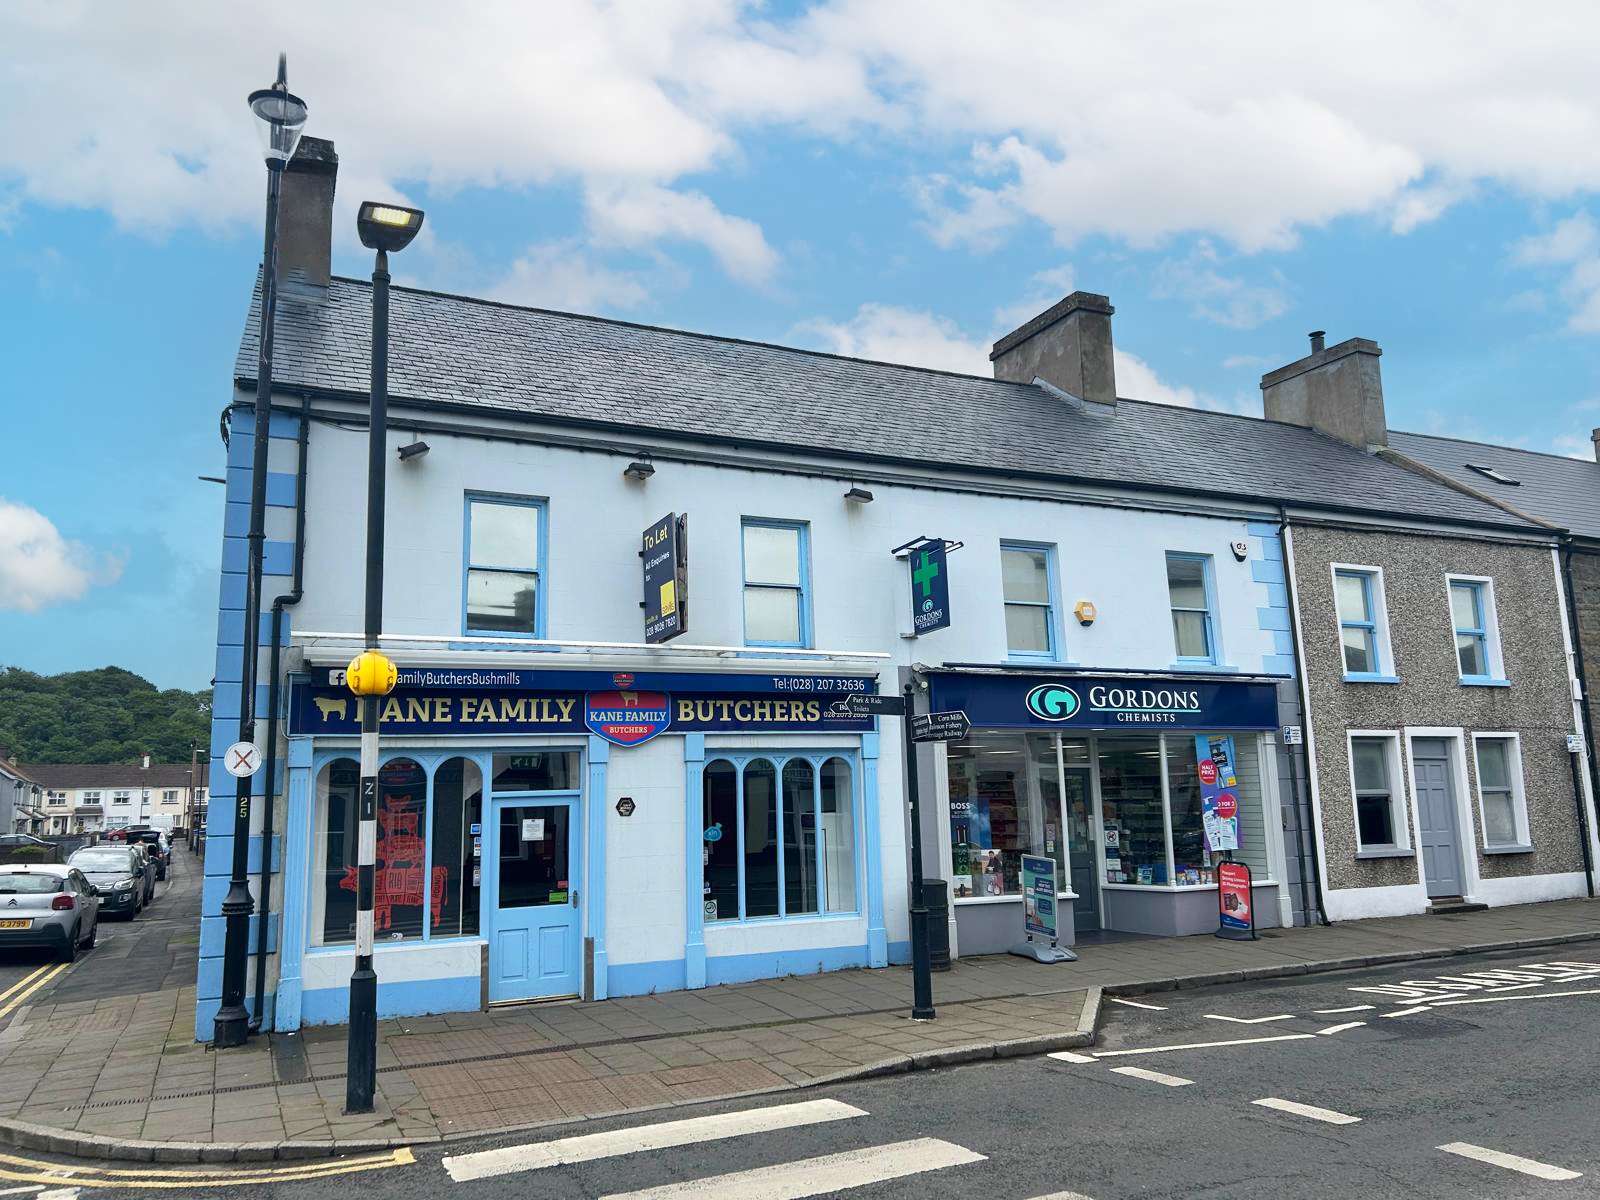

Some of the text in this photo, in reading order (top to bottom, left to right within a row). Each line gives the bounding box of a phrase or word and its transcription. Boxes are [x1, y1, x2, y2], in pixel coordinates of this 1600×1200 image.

[645, 524, 668, 550] To Let
[914, 608, 943, 625] GORDONS
[395, 671, 520, 688] amilyButchersBushmills
[773, 677, 865, 691] Tel:(028) 207 32636
[852, 696, 864, 704] Park
[1089, 686, 1200, 709] GORDONS
[460, 697, 577, 723] FAMILY
[677, 699, 821, 722] BUTCHERS
[853, 703, 870, 712] Toilets
[589, 711, 667, 722] KANE FAMILY
[1117, 712, 1176, 723] CHEMISTS
[609, 726, 648, 734] BUTCHERS
[944, 730, 963, 739] Railway
[950, 802, 971, 810] BOSS
